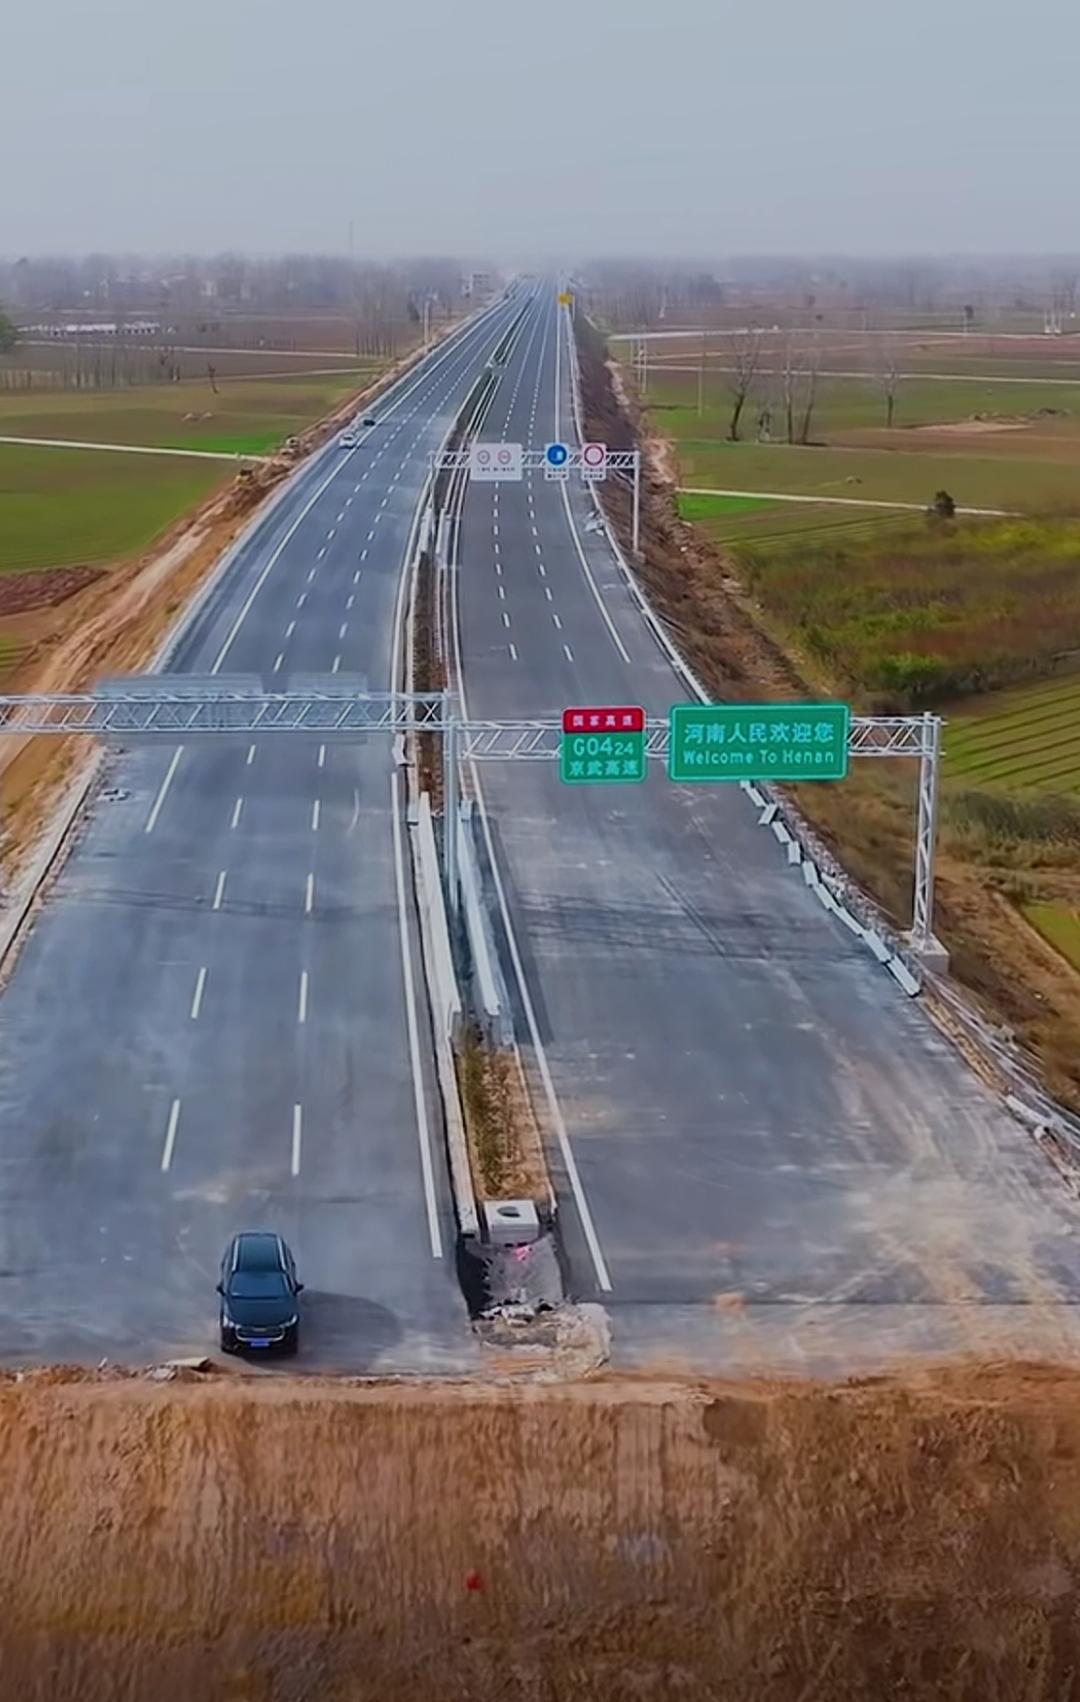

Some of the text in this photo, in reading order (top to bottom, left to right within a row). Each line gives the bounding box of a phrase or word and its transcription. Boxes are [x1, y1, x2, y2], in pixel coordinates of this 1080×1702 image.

[684, 723, 834, 744] 河南人民欢迎您
[573, 737, 634, 756] G0424
[683, 750, 835, 765] Welcome To Henan
